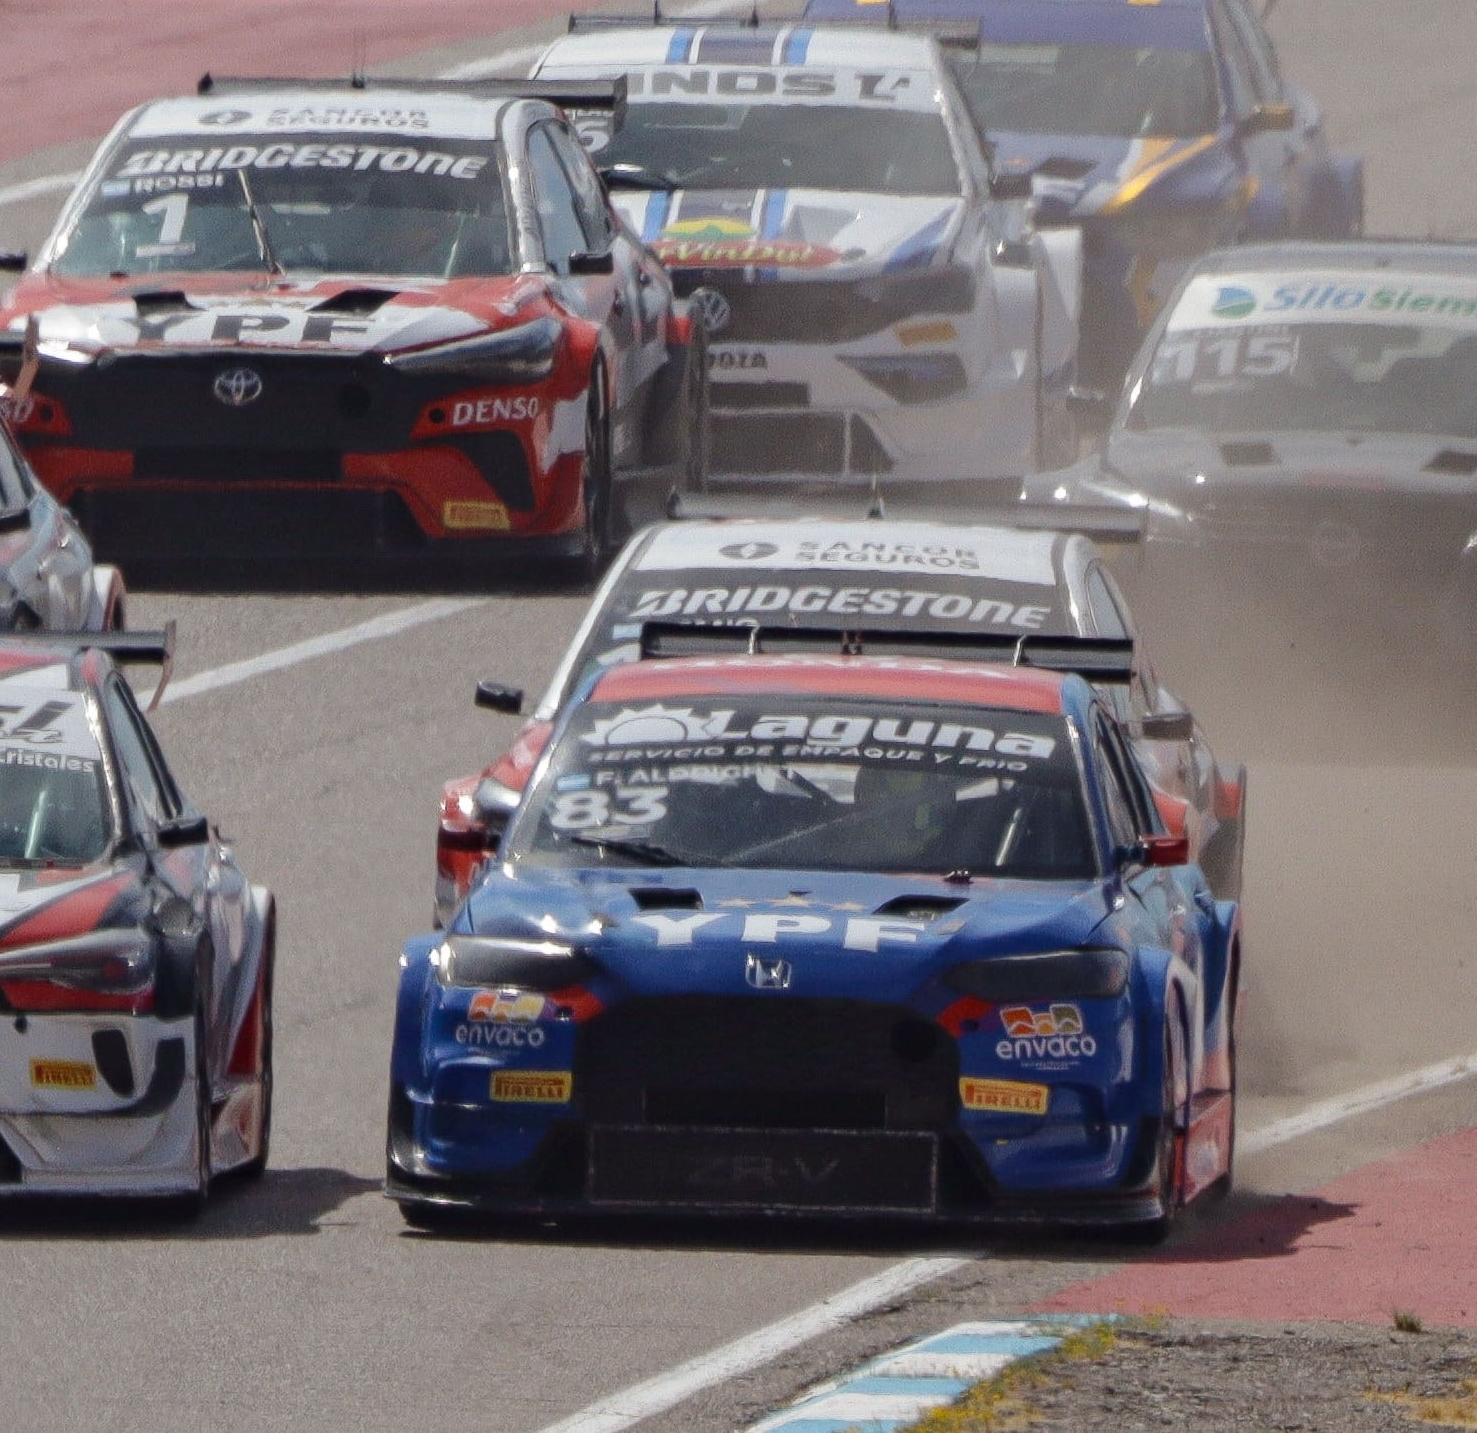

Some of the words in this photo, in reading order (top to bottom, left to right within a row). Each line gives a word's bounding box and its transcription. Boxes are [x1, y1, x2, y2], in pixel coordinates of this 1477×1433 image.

[119, 143, 489, 180] BRIDGESTONE
[135, 174, 224, 194] ROSSI
[126, 312, 380, 344] YPF
[451, 396, 541, 427] DENSO
[794, 551, 980, 570] SEGUROS
[799, 540, 977, 559] SANCOR
[629, 584, 1052, 629] BRIDGESTONE
[710, 709, 1056, 759] Laguna
[588, 744, 723, 764] SERVICIO
[734, 744, 771, 758] DE
[782, 744, 924, 763] EMPAQUE
[550, 786, 669, 828] 83
[631, 912, 924, 952] YPF
[455, 1024, 546, 1048] envaco
[994, 1035, 1097, 1060] envaco
[494, 1075, 566, 1099] PIRELLI
[964, 1083, 1045, 1112] PIRELLI
